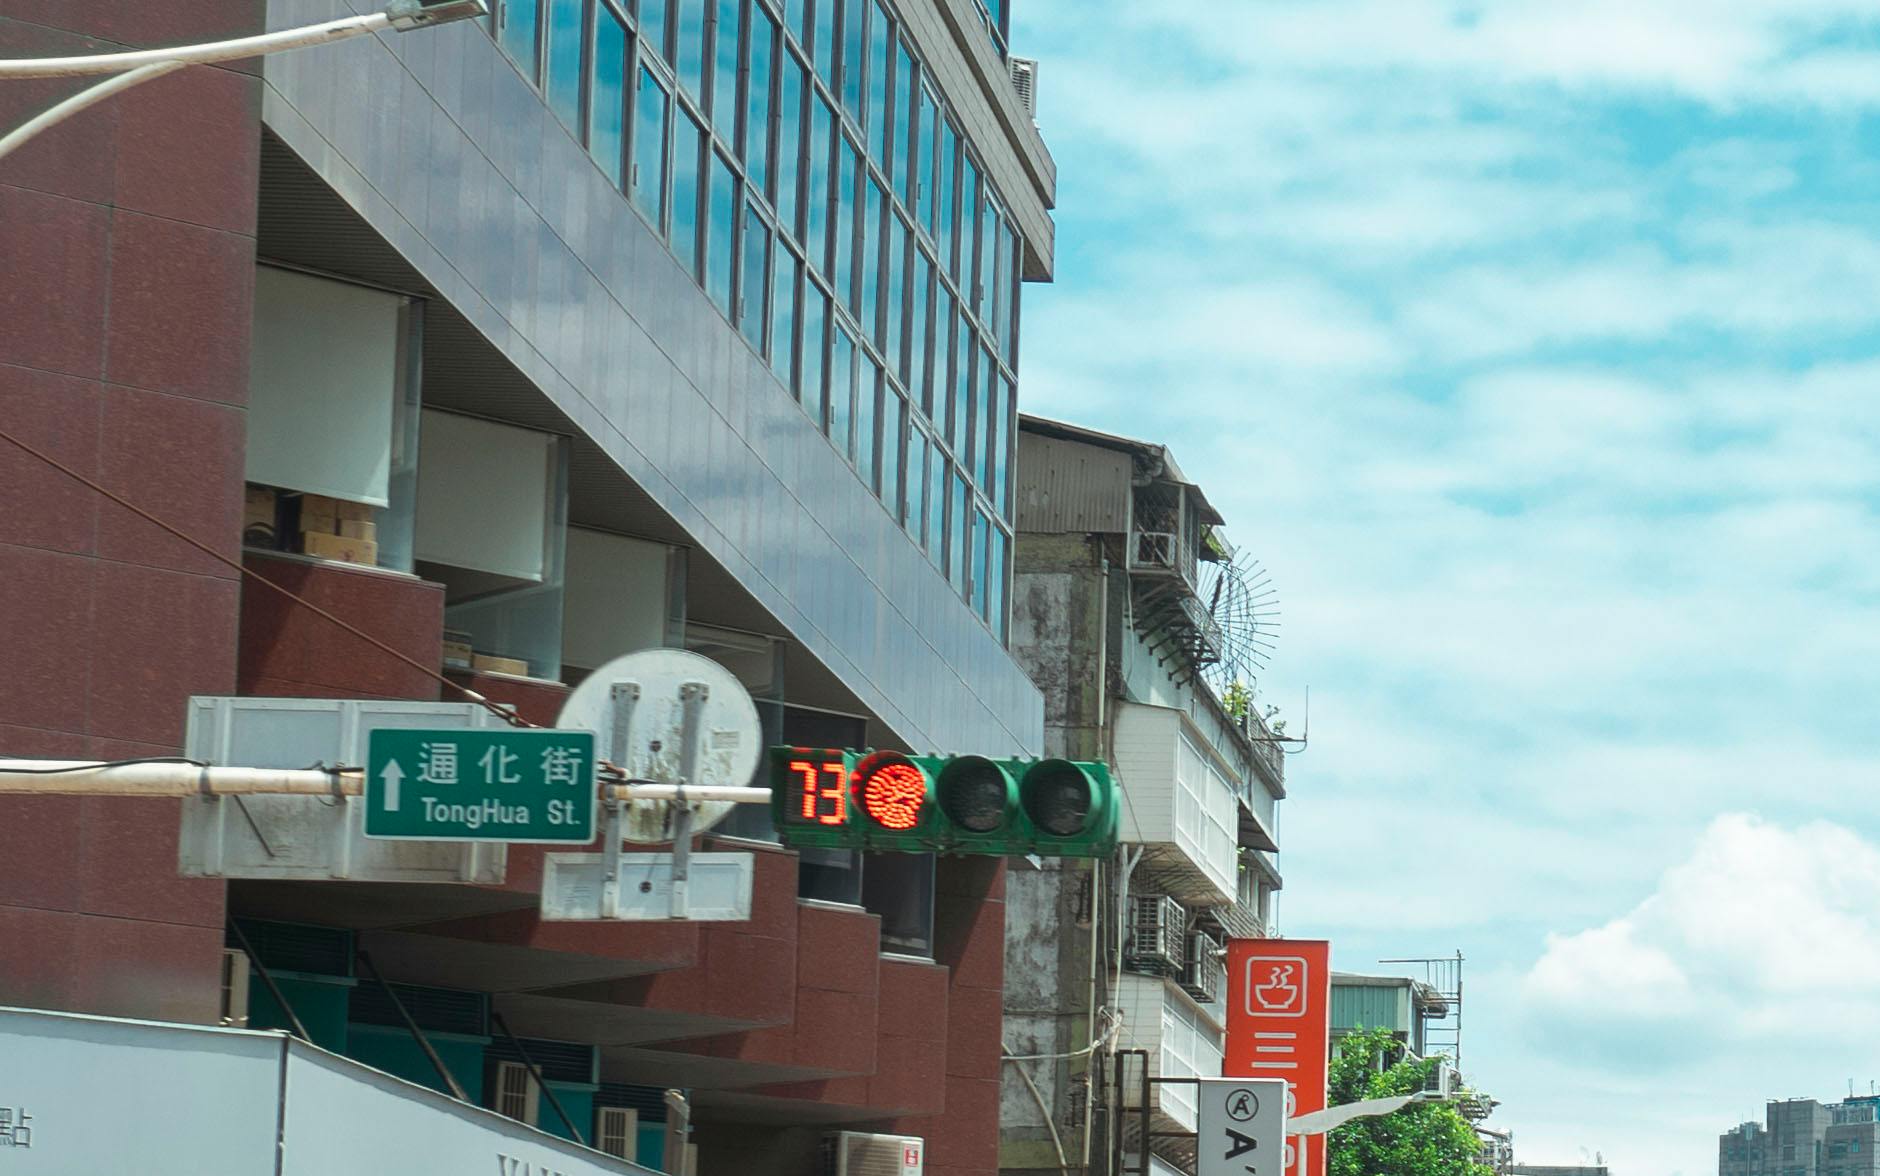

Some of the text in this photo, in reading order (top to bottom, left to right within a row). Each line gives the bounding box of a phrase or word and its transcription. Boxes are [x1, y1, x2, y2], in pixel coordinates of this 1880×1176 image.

[416, 742, 583, 785] 通化街
[421, 797, 581, 829] TongHua St.
[790, 760, 847, 826] 73
